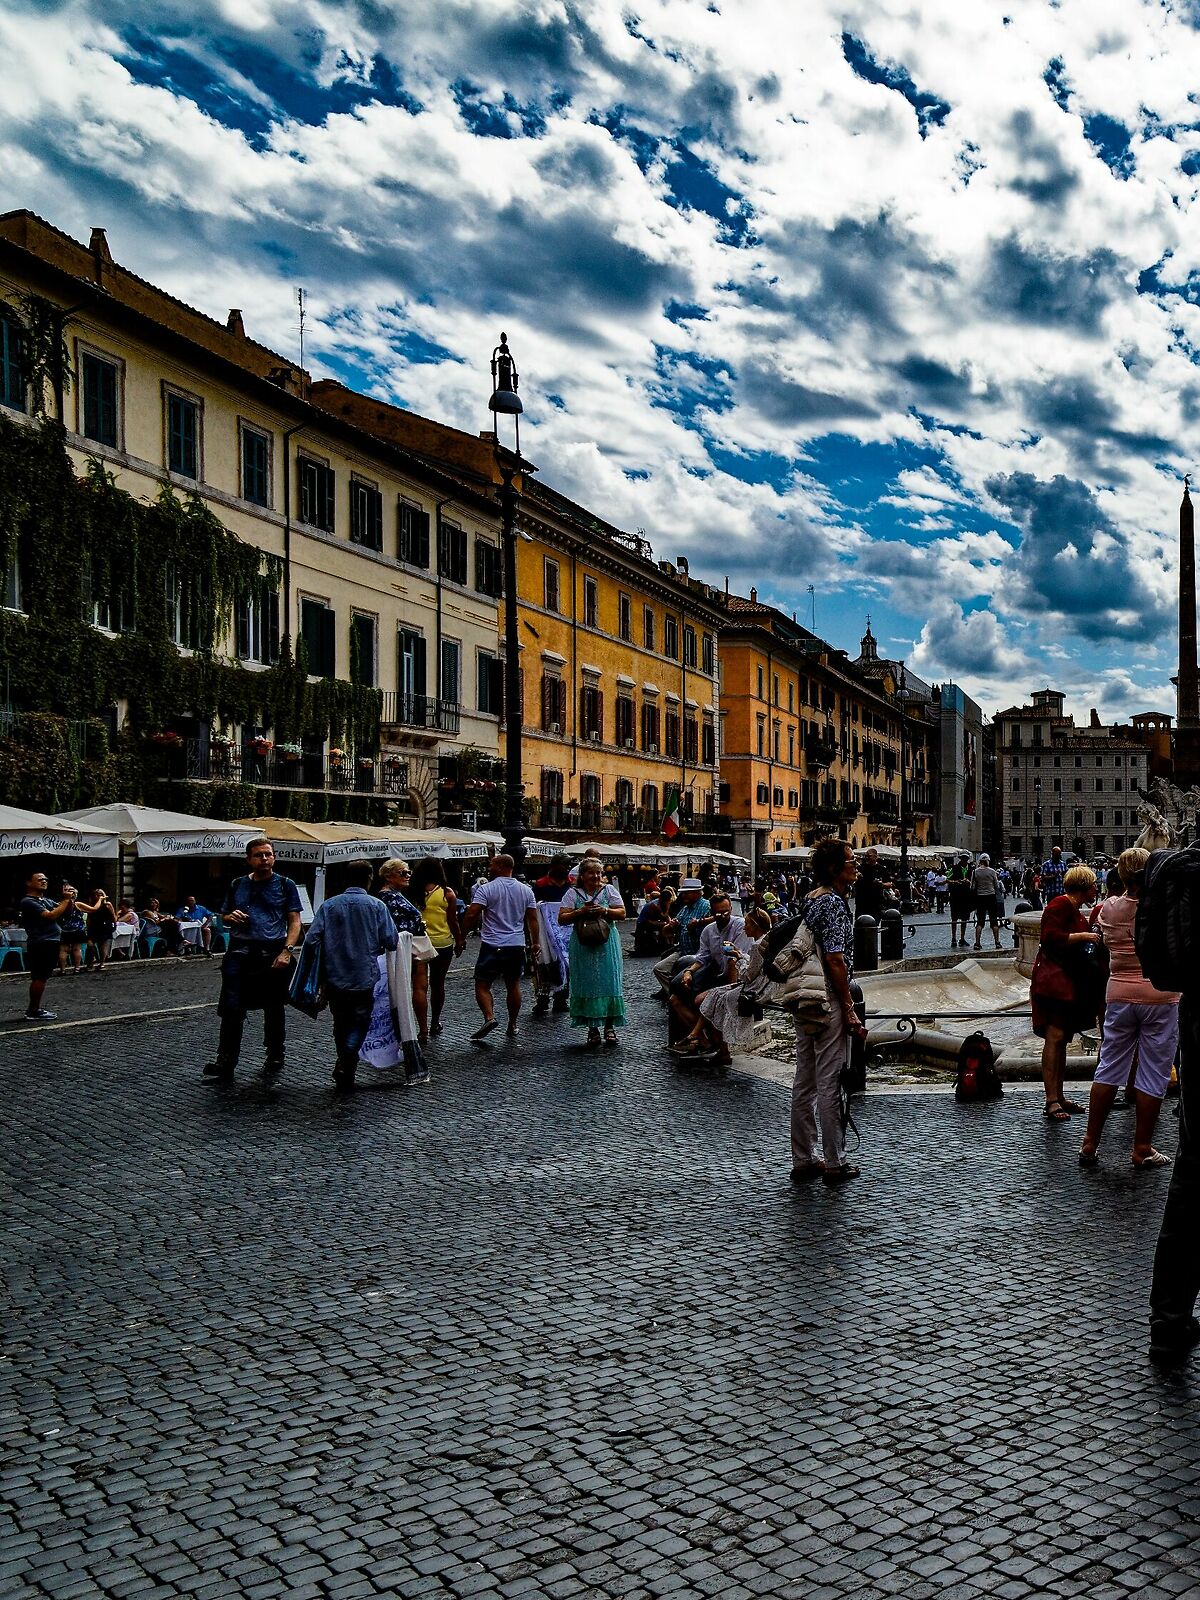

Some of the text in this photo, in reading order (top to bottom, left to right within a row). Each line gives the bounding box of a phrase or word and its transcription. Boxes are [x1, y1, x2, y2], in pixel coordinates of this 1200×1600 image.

[42, 833, 91, 852] Ristorante
[162, 834, 245, 852] Ristorante Dolce Vita
[274, 848, 319, 859] reakfast
